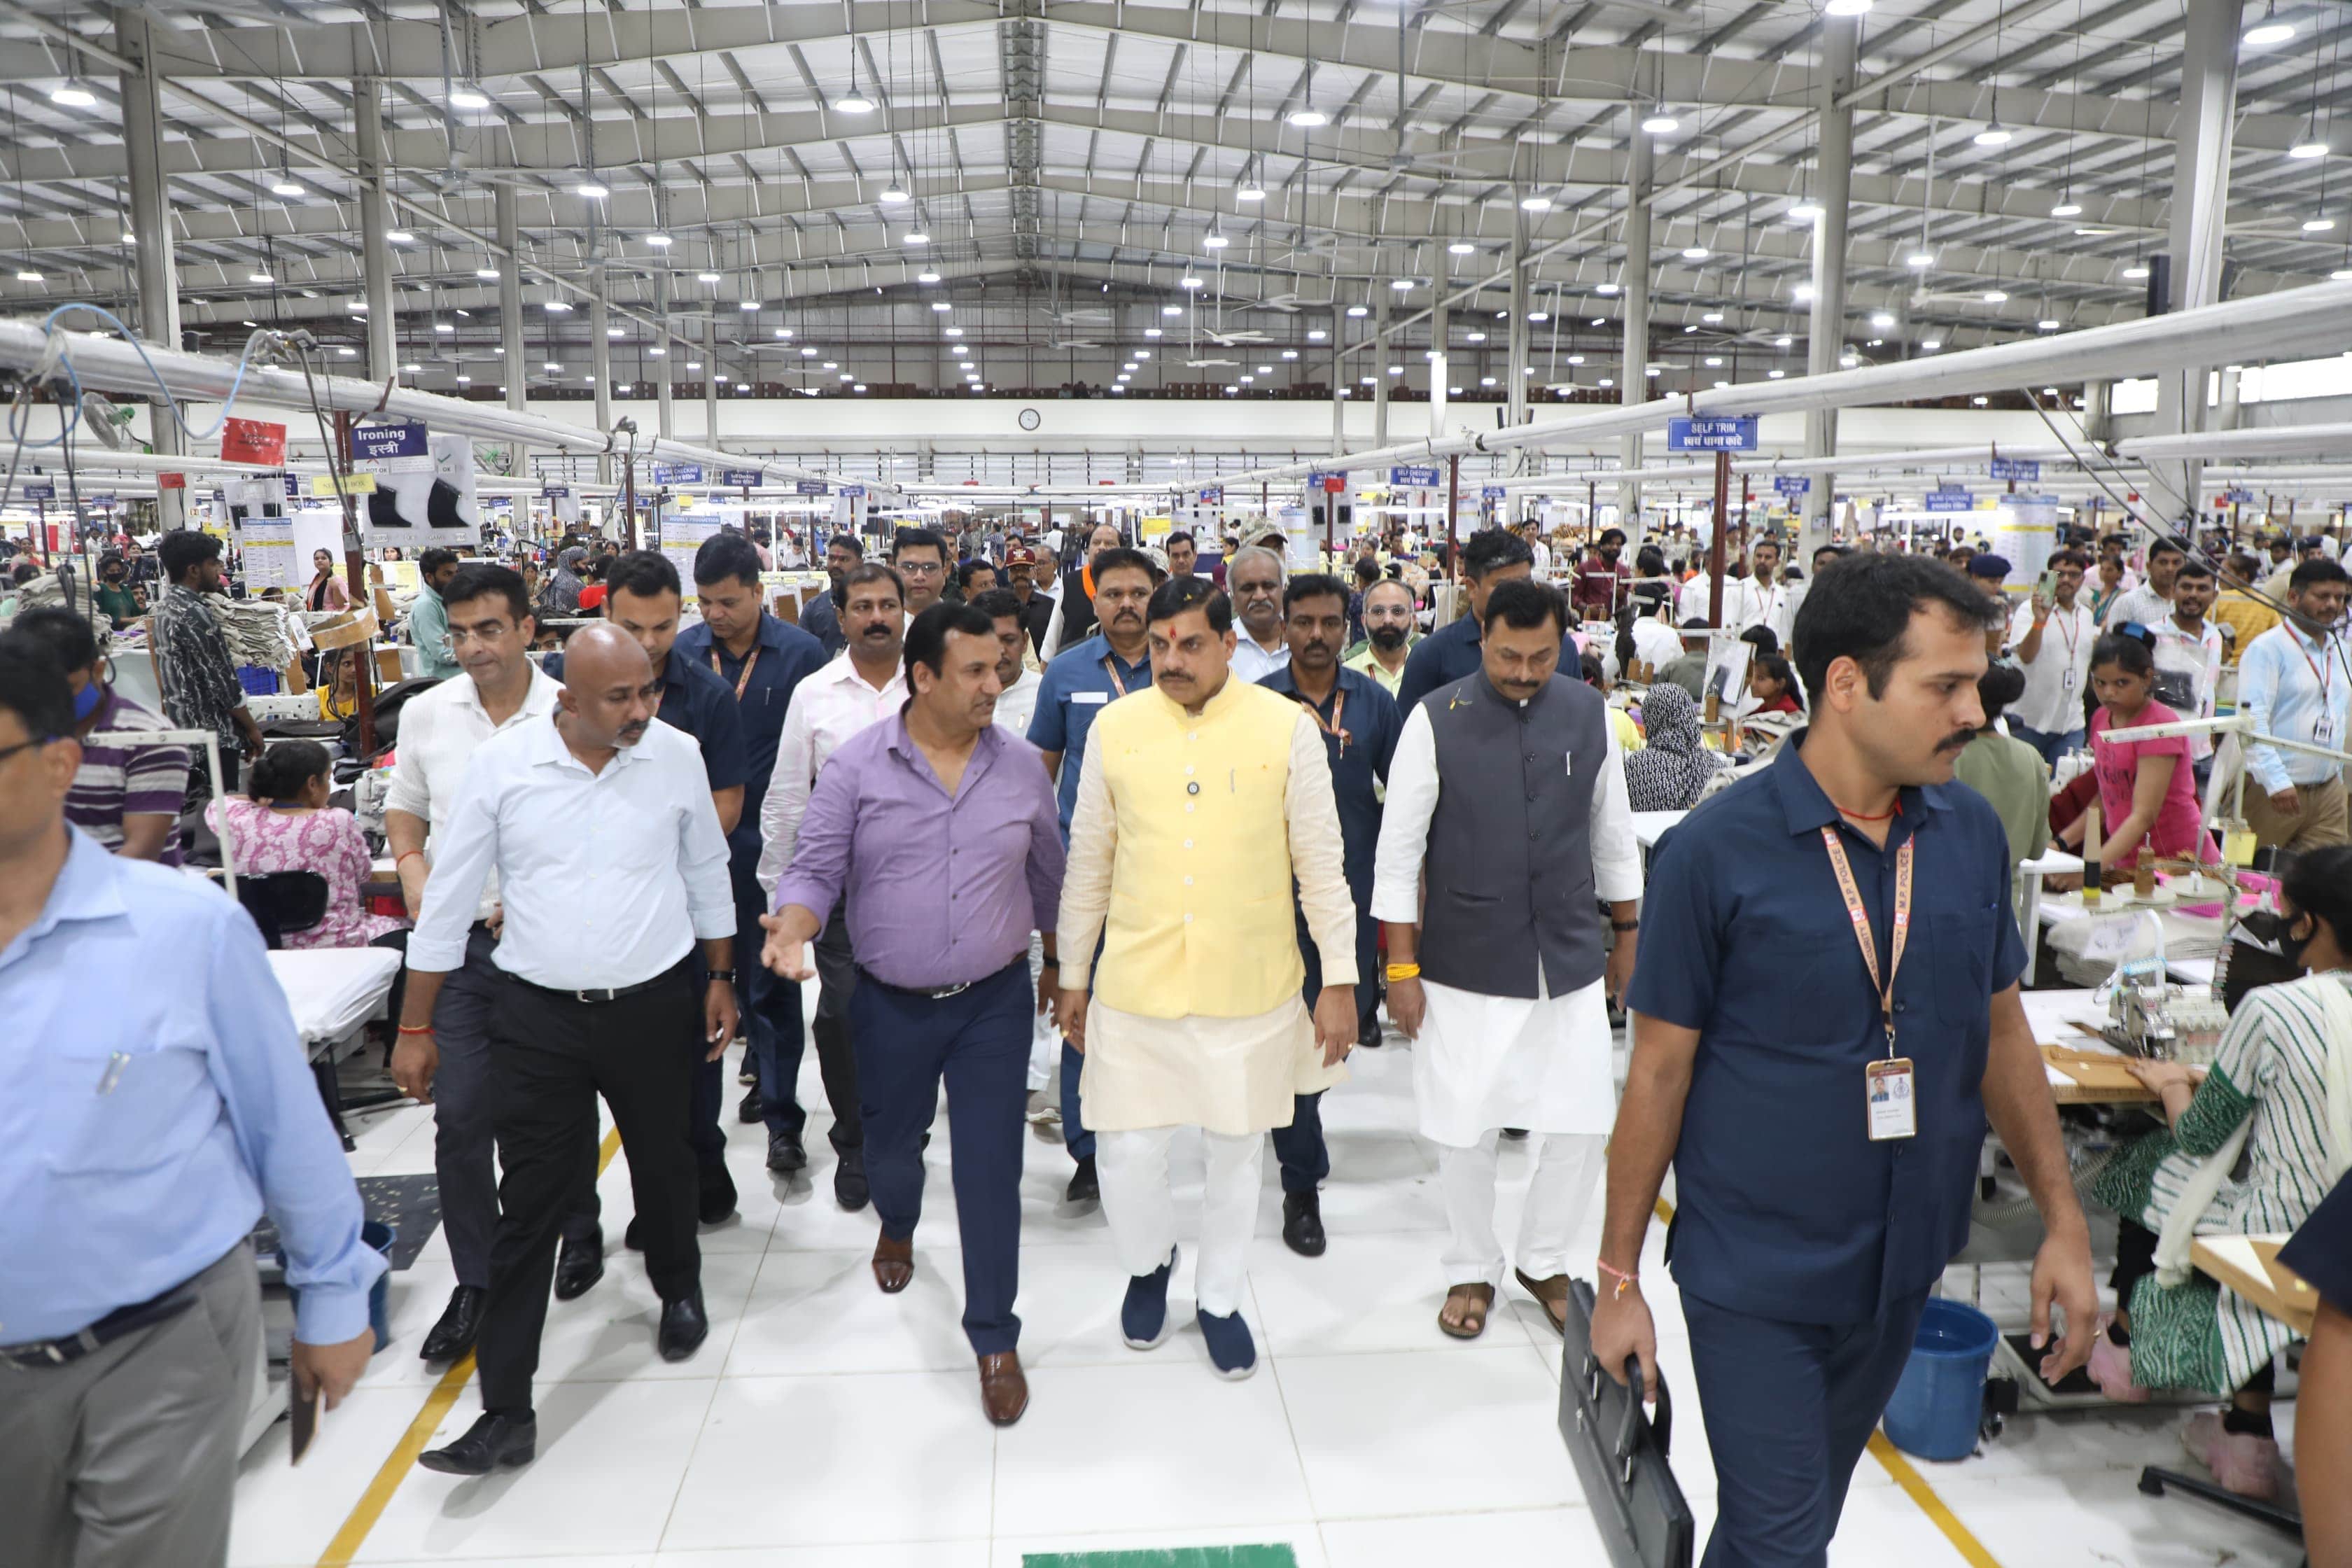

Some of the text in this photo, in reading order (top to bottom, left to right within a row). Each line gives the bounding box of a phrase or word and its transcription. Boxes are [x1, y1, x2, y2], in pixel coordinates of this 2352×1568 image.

[358, 429, 406, 441] Ironing
[1691, 422, 1736, 434] SELF TRIM
[368, 442, 400, 456] इस्त्री
[1832, 848, 1849, 884] POLICE
[1900, 851, 1909, 888] POLICE
